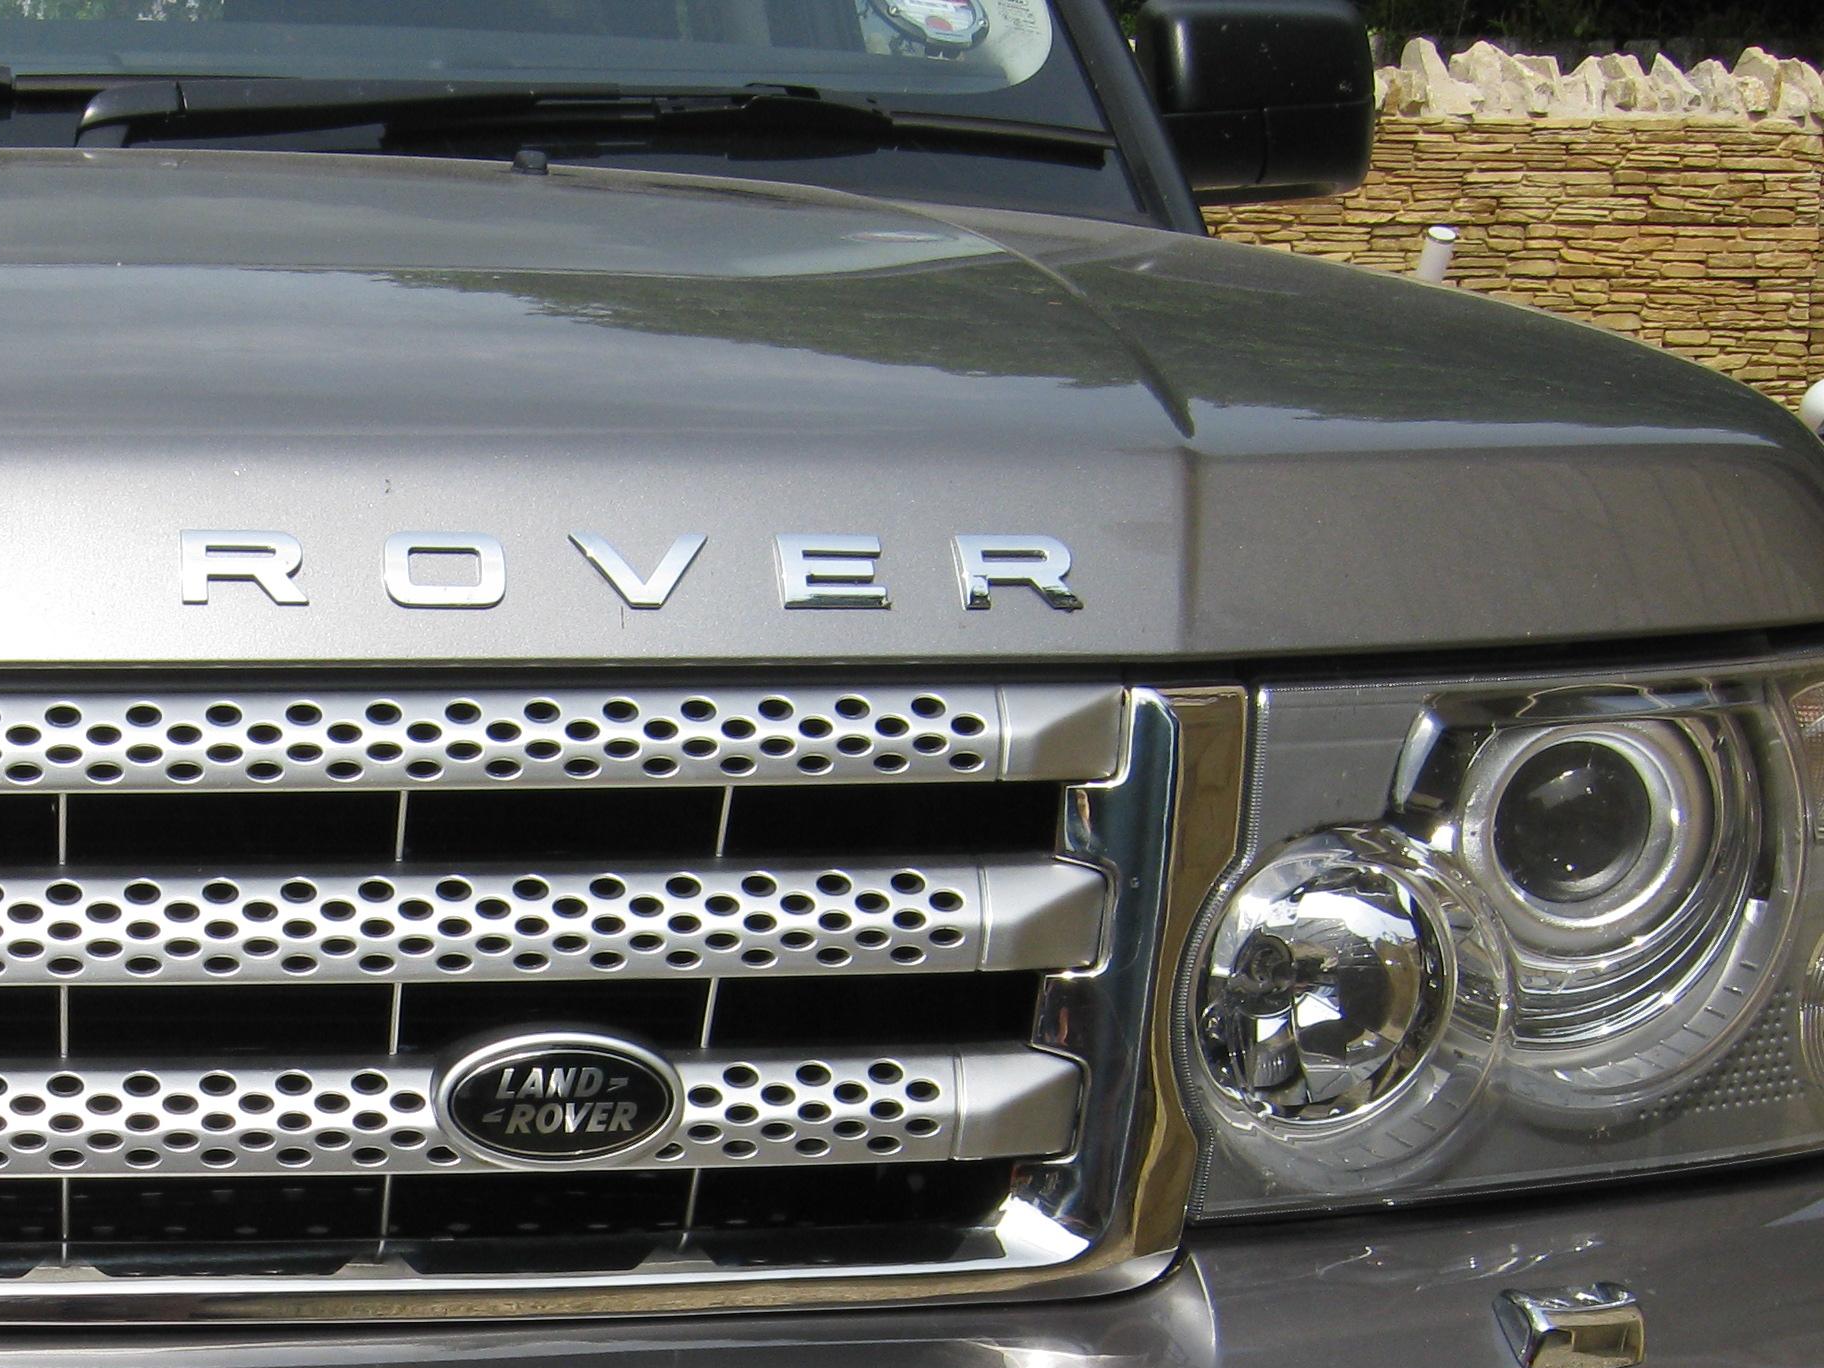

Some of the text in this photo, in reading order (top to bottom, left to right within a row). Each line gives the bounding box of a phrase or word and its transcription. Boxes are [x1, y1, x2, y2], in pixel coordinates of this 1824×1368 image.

[180, 529, 1084, 612] ROVER
[495, 1067, 604, 1099] LAND
[504, 1102, 637, 1135] ROVER
